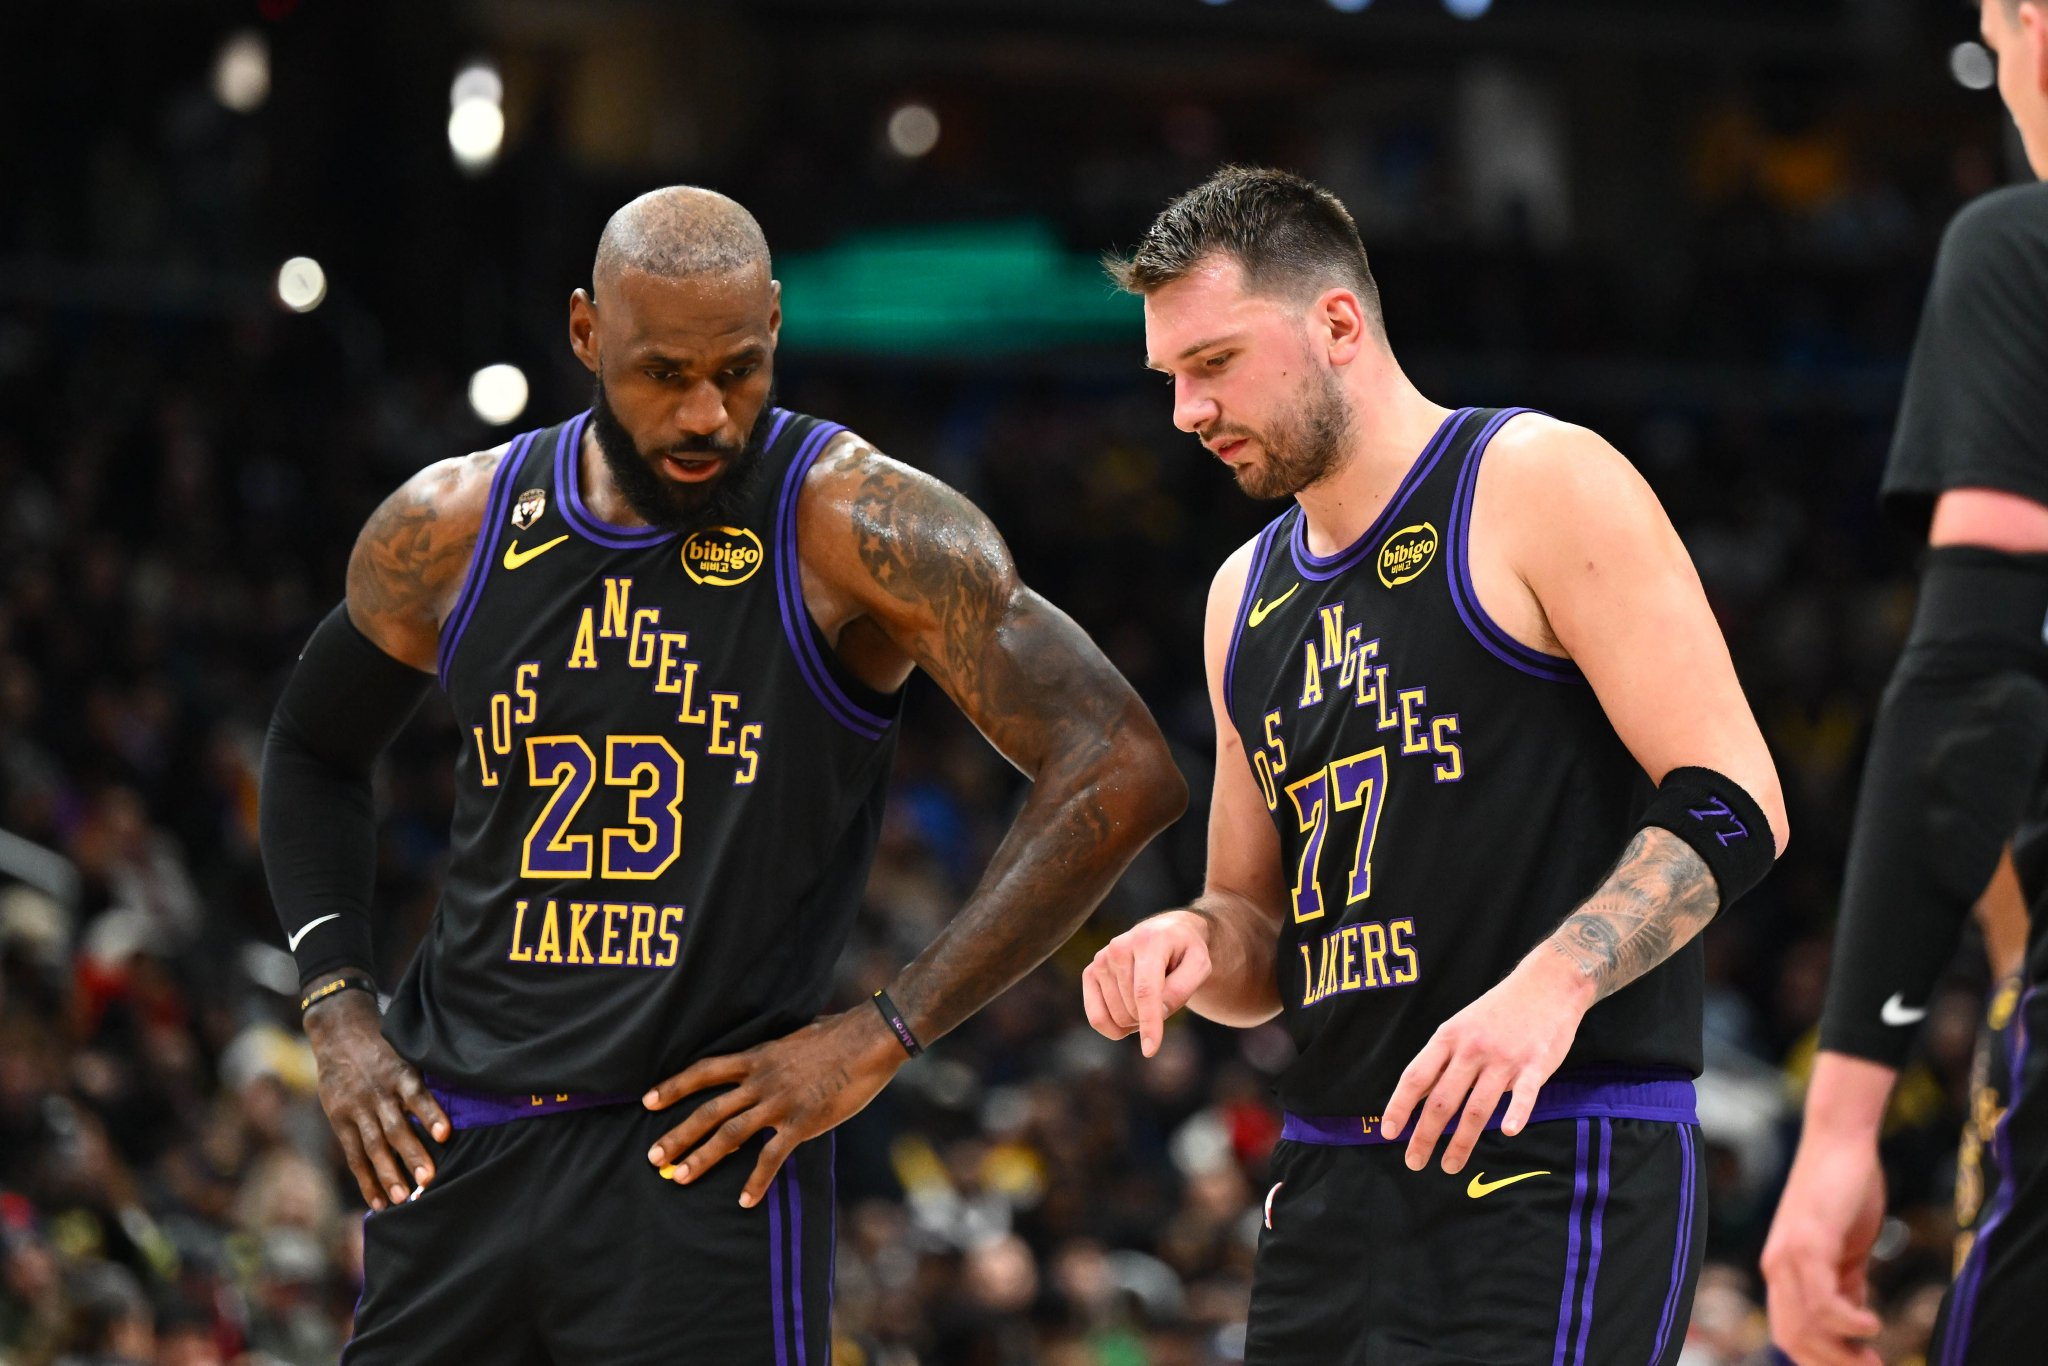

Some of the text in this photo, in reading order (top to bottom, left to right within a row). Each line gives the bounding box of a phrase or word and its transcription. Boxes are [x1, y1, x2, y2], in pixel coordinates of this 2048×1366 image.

[689, 540, 759, 570] bibigo
[1383, 540, 1435, 568] bibigo
[472, 575, 764, 788] LOS ANGELES
[1253, 600, 1466, 811] OS ANGELES
[519, 733, 686, 881] 23
[1284, 745, 1388, 924] 77
[1687, 796, 1749, 847] 77
[508, 899, 685, 968] LAKERS
[1298, 917, 1420, 1009] LAKERS
